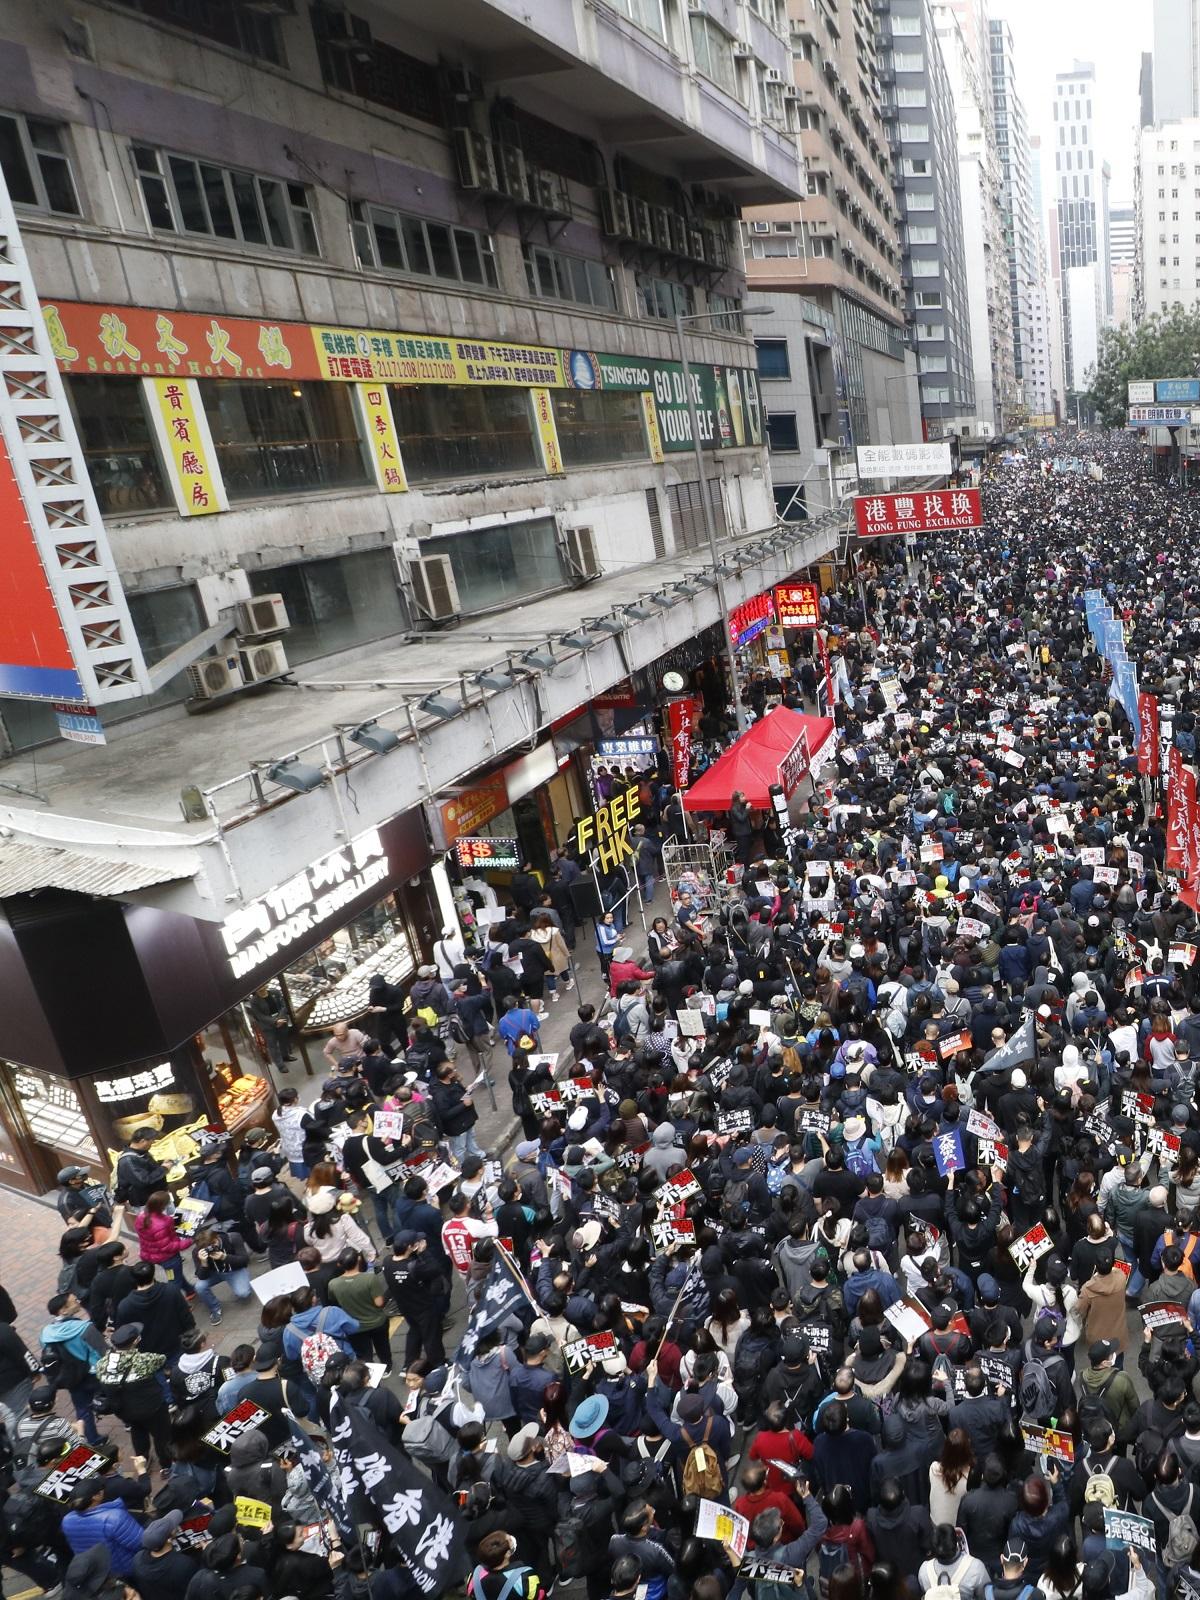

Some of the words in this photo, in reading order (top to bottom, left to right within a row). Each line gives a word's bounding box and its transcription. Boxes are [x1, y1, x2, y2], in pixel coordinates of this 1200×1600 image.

[601, 367, 650, 386] TSINGTAO
[654, 370, 672, 404] GO
[659, 409, 713, 442] YOURELF
[164, 385, 209, 507] 貴賓廳房
[368, 391, 401, 486] 四季火鍋
[864, 493, 973, 522] 港豐找換
[867, 521, 894, 533] KONG
[897, 519, 921, 530] FUNG
[926, 515, 974, 529] EXCHANGE
[602, 739, 653, 754] 專業維修
[577, 784, 641, 855] FREE
[598, 825, 635, 876] HK
[474, 857, 517, 865] EXCHANGE
[718, 1110, 750, 1122] 五大訴求
[803, 1111, 830, 1123] 五大訴求
[449, 1235, 467, 1250] 13
[980, 1358, 1012, 1375] 五大訴求
[1111, 1517, 1150, 1537] 2020
